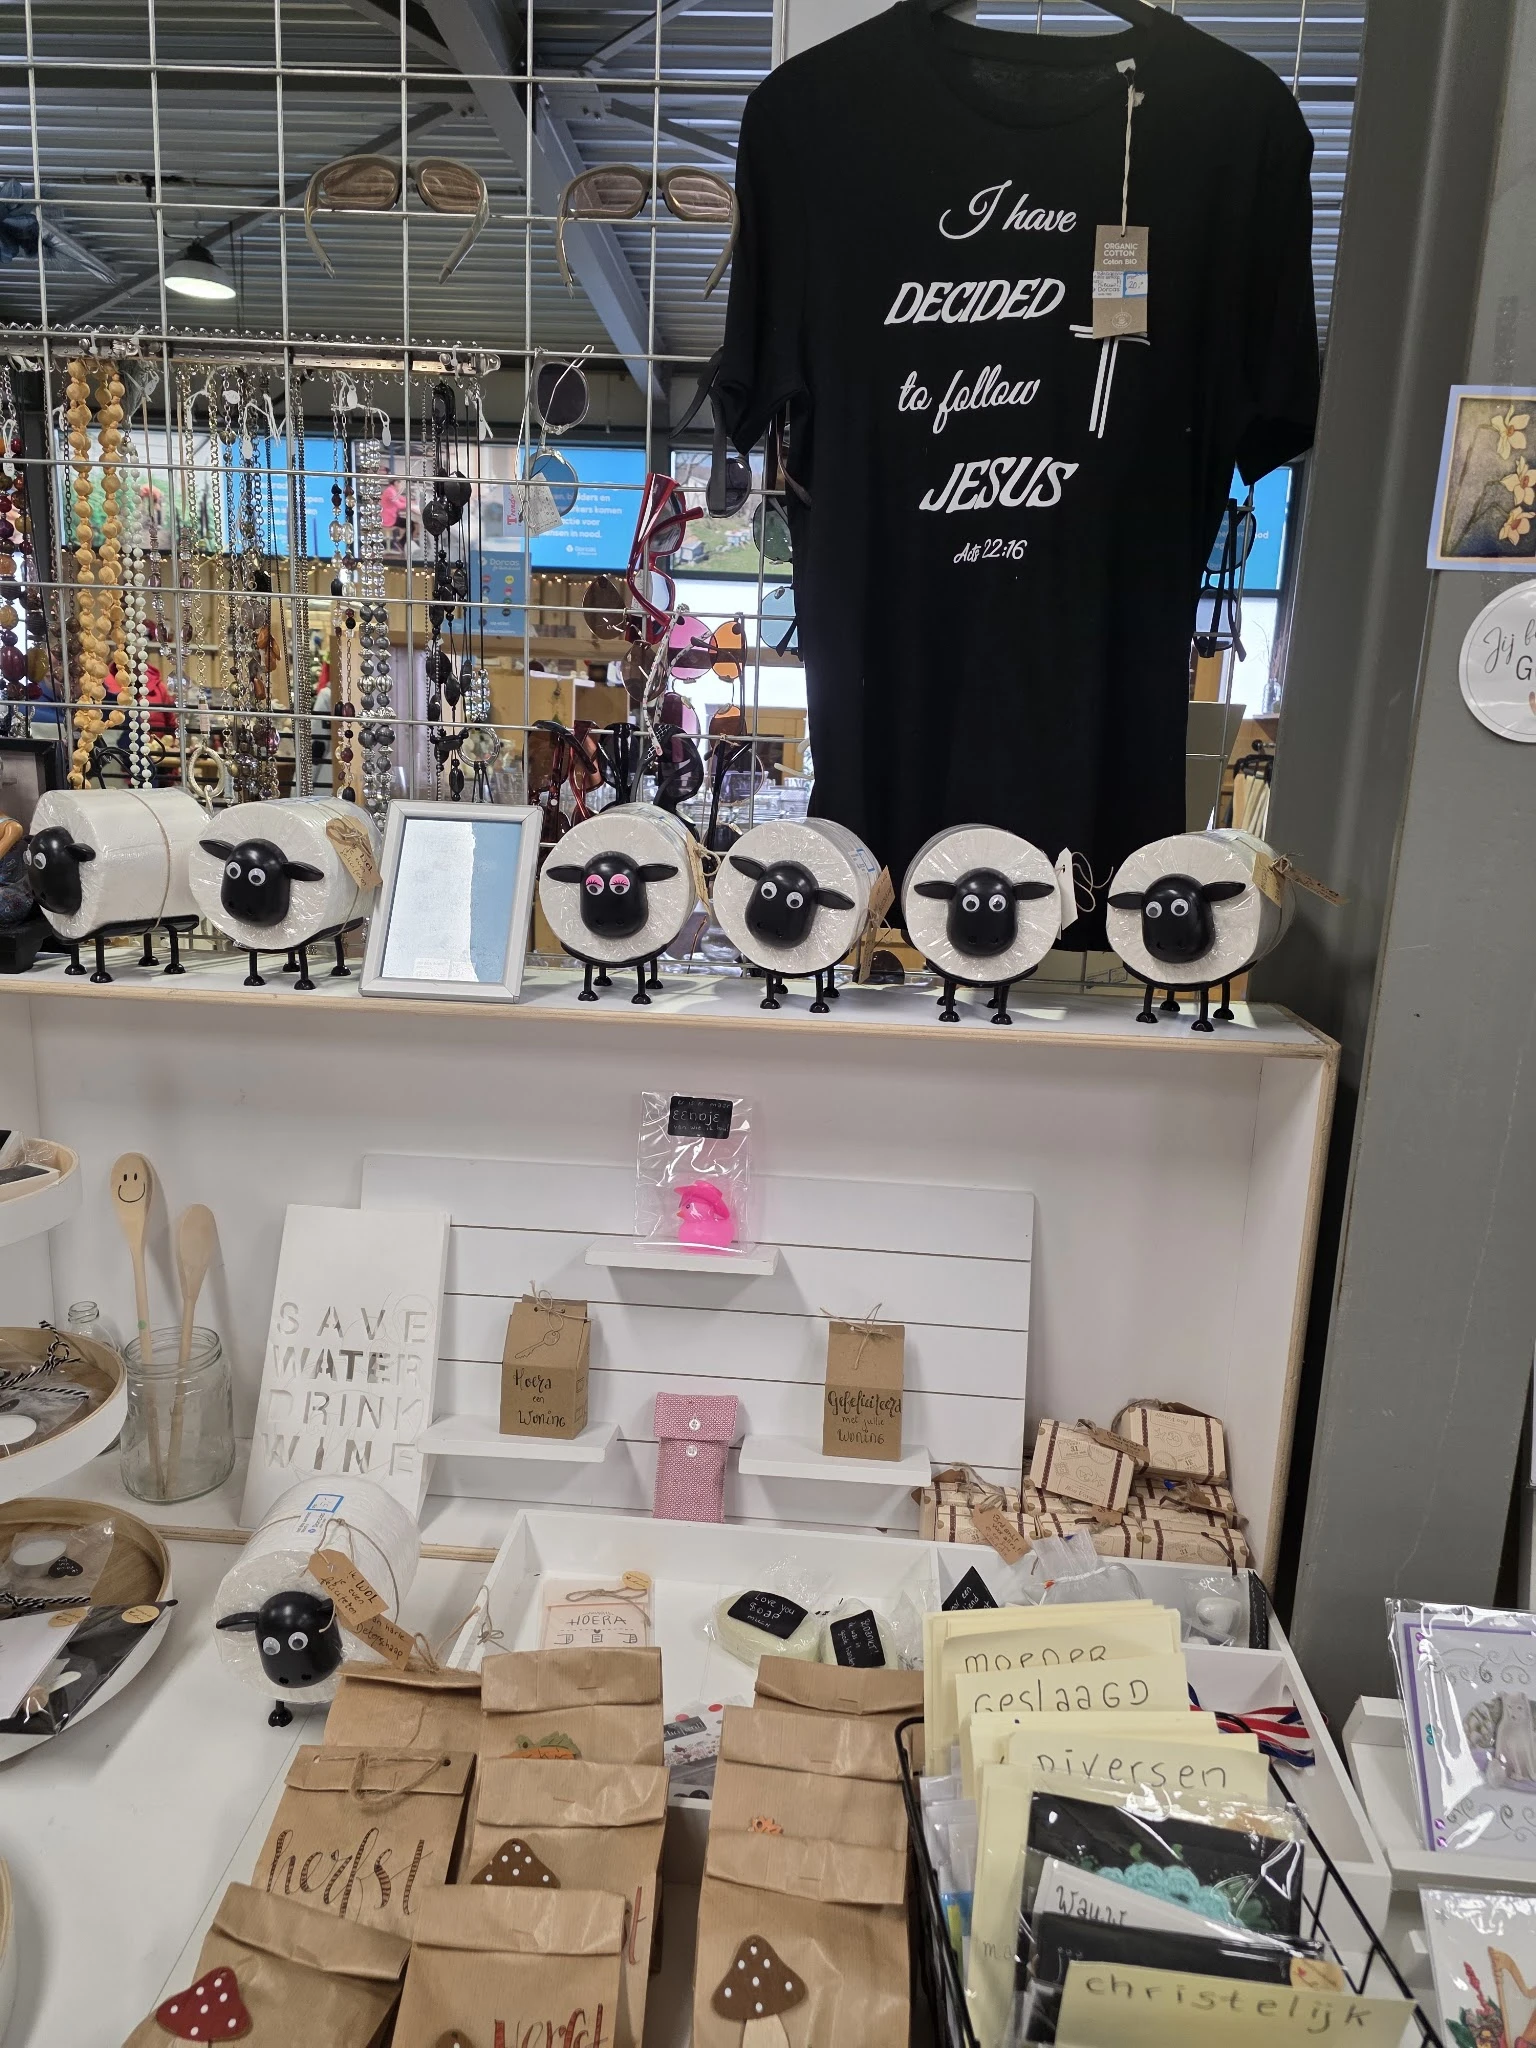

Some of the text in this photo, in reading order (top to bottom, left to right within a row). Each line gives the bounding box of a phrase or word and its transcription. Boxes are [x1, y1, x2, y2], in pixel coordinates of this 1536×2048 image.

[939, 179, 1077, 239] I have
[1102, 258, 1123, 266] Coton
[1103, 242, 1139, 250] ORGANIC
[1103, 249, 1135, 257] COTTON
[884, 277, 1066, 326] DECIDED
[898, 363, 1041, 435] to follow
[918, 456, 1080, 514] JESUS
[952, 538, 1028, 564] Acts 22:16
[1482, 626, 1516, 674] Jij
[277, 1301, 428, 1343] SAVE
[272, 1345, 424, 1388] WATER
[266, 1387, 423, 1431] DRINK
[260, 1431, 416, 1477] WINE
[960, 1586, 973, 1600] een
[371, 1615, 383, 1628] an
[565, 1614, 628, 1627] HOERA
[1084, 1974, 1374, 2036] christelijk
